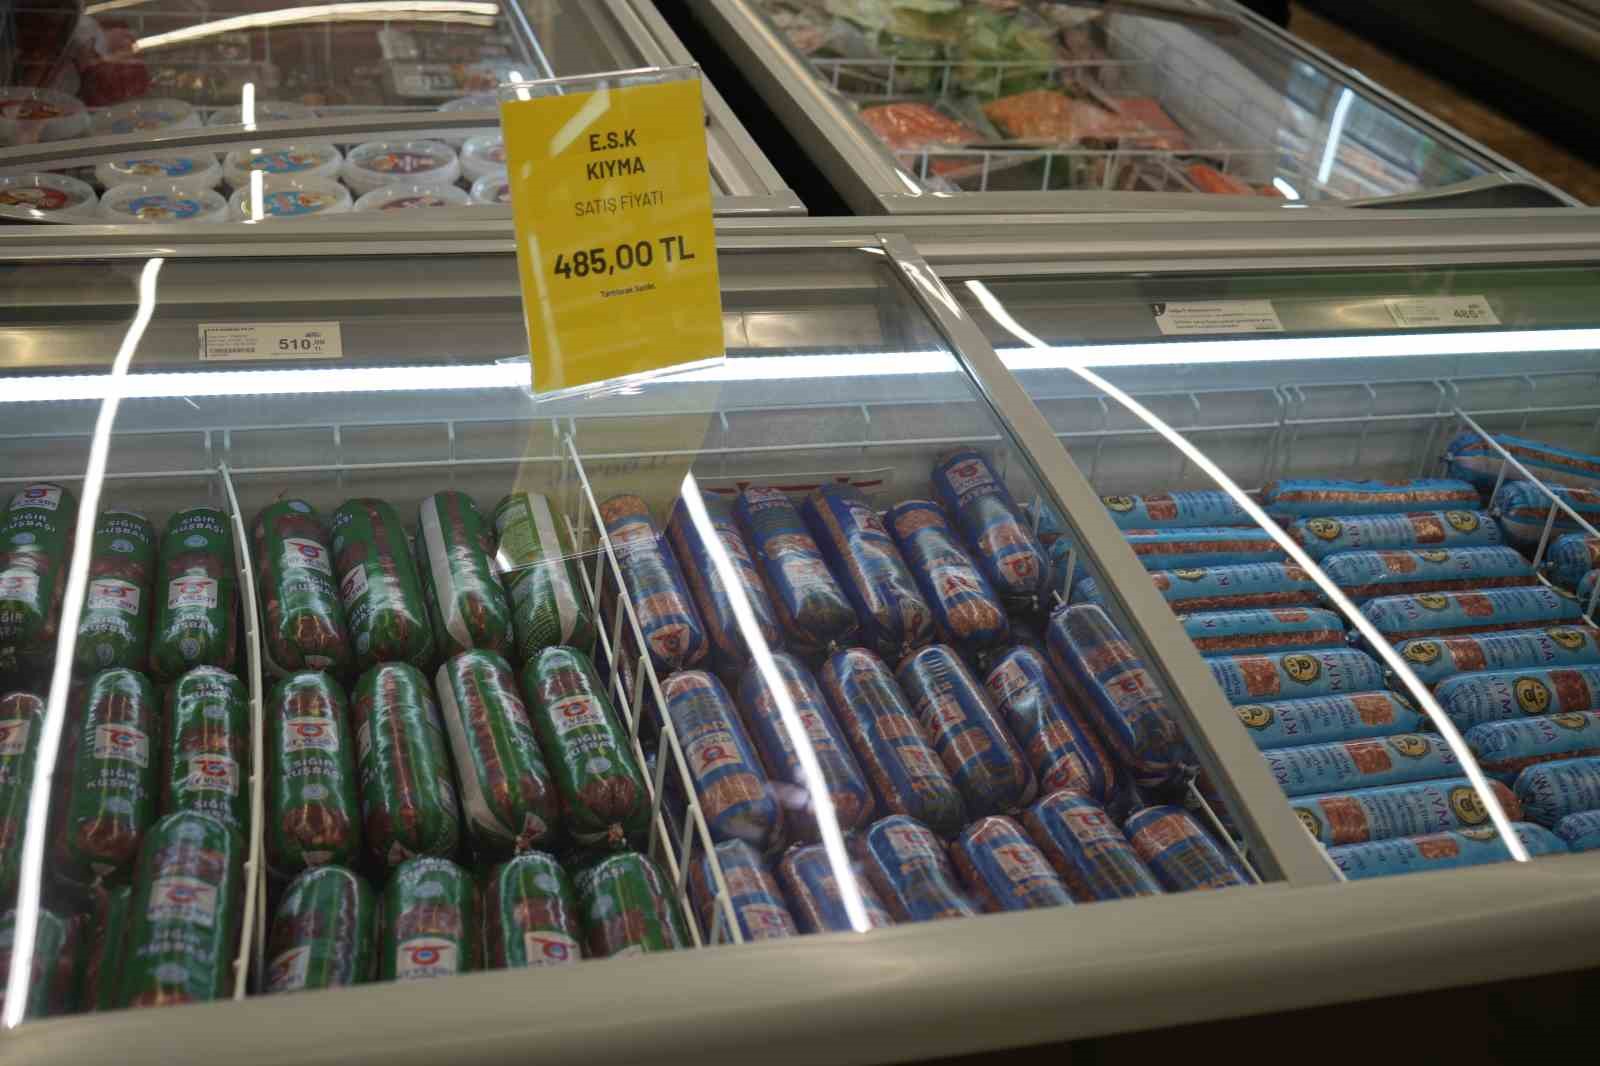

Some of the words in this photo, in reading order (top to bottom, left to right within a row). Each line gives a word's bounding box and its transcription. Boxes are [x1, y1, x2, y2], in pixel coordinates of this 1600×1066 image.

[589, 129, 637, 152] E.S.K
[586, 156, 645, 180] KIYMA
[575, 196, 619, 218] SATIŞ
[621, 190, 664, 211] FİYATI
[554, 240, 654, 280] 485,00
[658, 235, 695, 264] TL
[279, 338, 311, 350] 510
